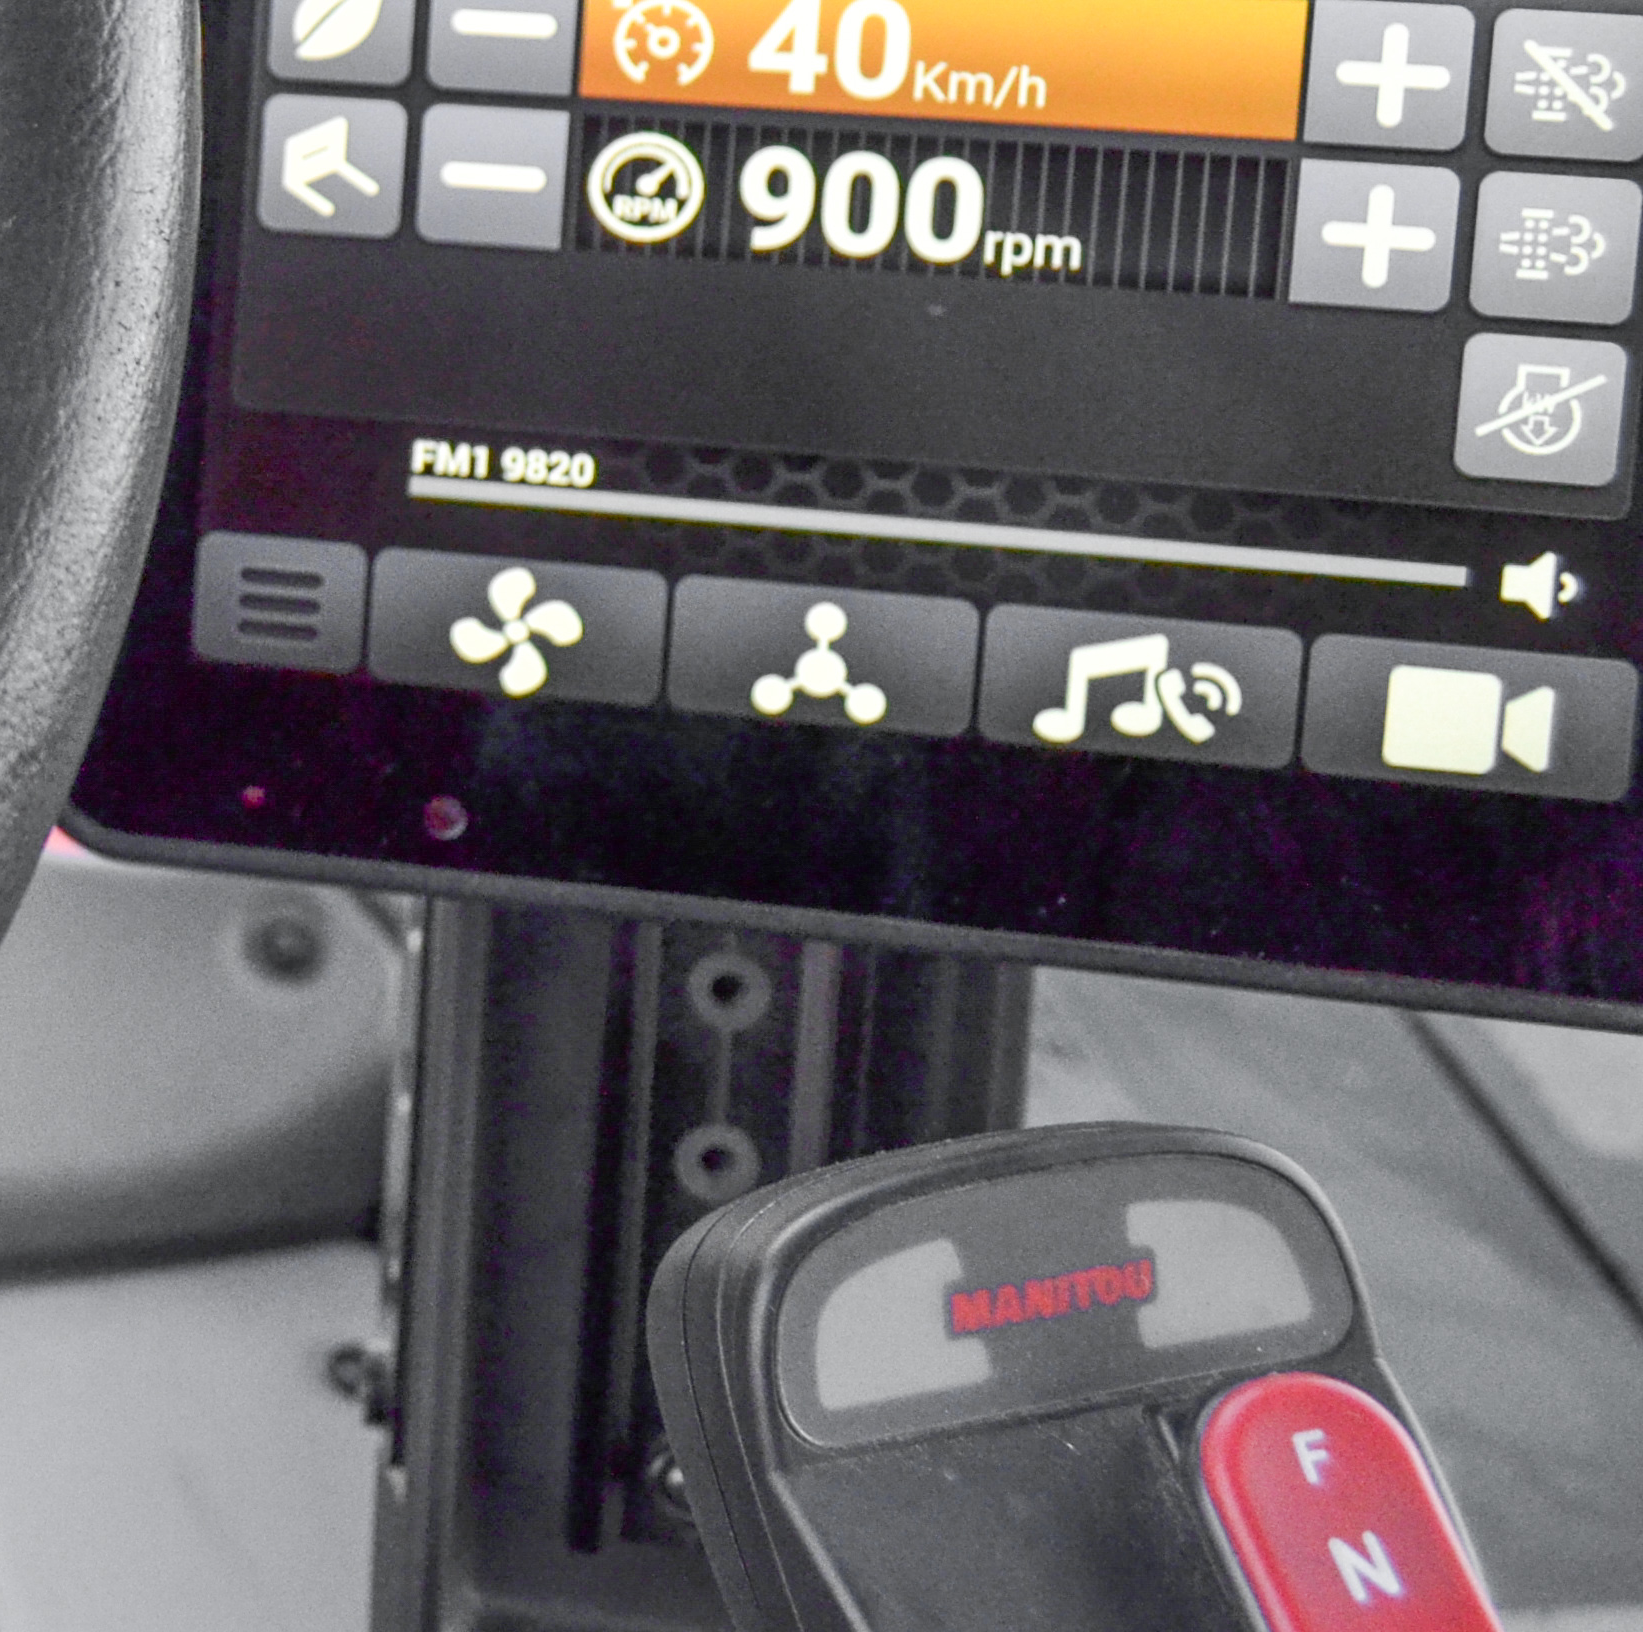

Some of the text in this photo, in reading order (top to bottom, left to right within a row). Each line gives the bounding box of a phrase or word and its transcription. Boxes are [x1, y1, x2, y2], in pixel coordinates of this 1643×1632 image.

[912, 60, 1048, 110] Km/h
[611, 194, 679, 224] RPM
[739, 144, 1084, 278] 900 rpm
[411, 436, 597, 490] FM1 9820
[949, 1258, 1155, 1334] MANITOU
[1292, 1428, 1329, 1485] F
[1327, 1529, 1404, 1604] N
